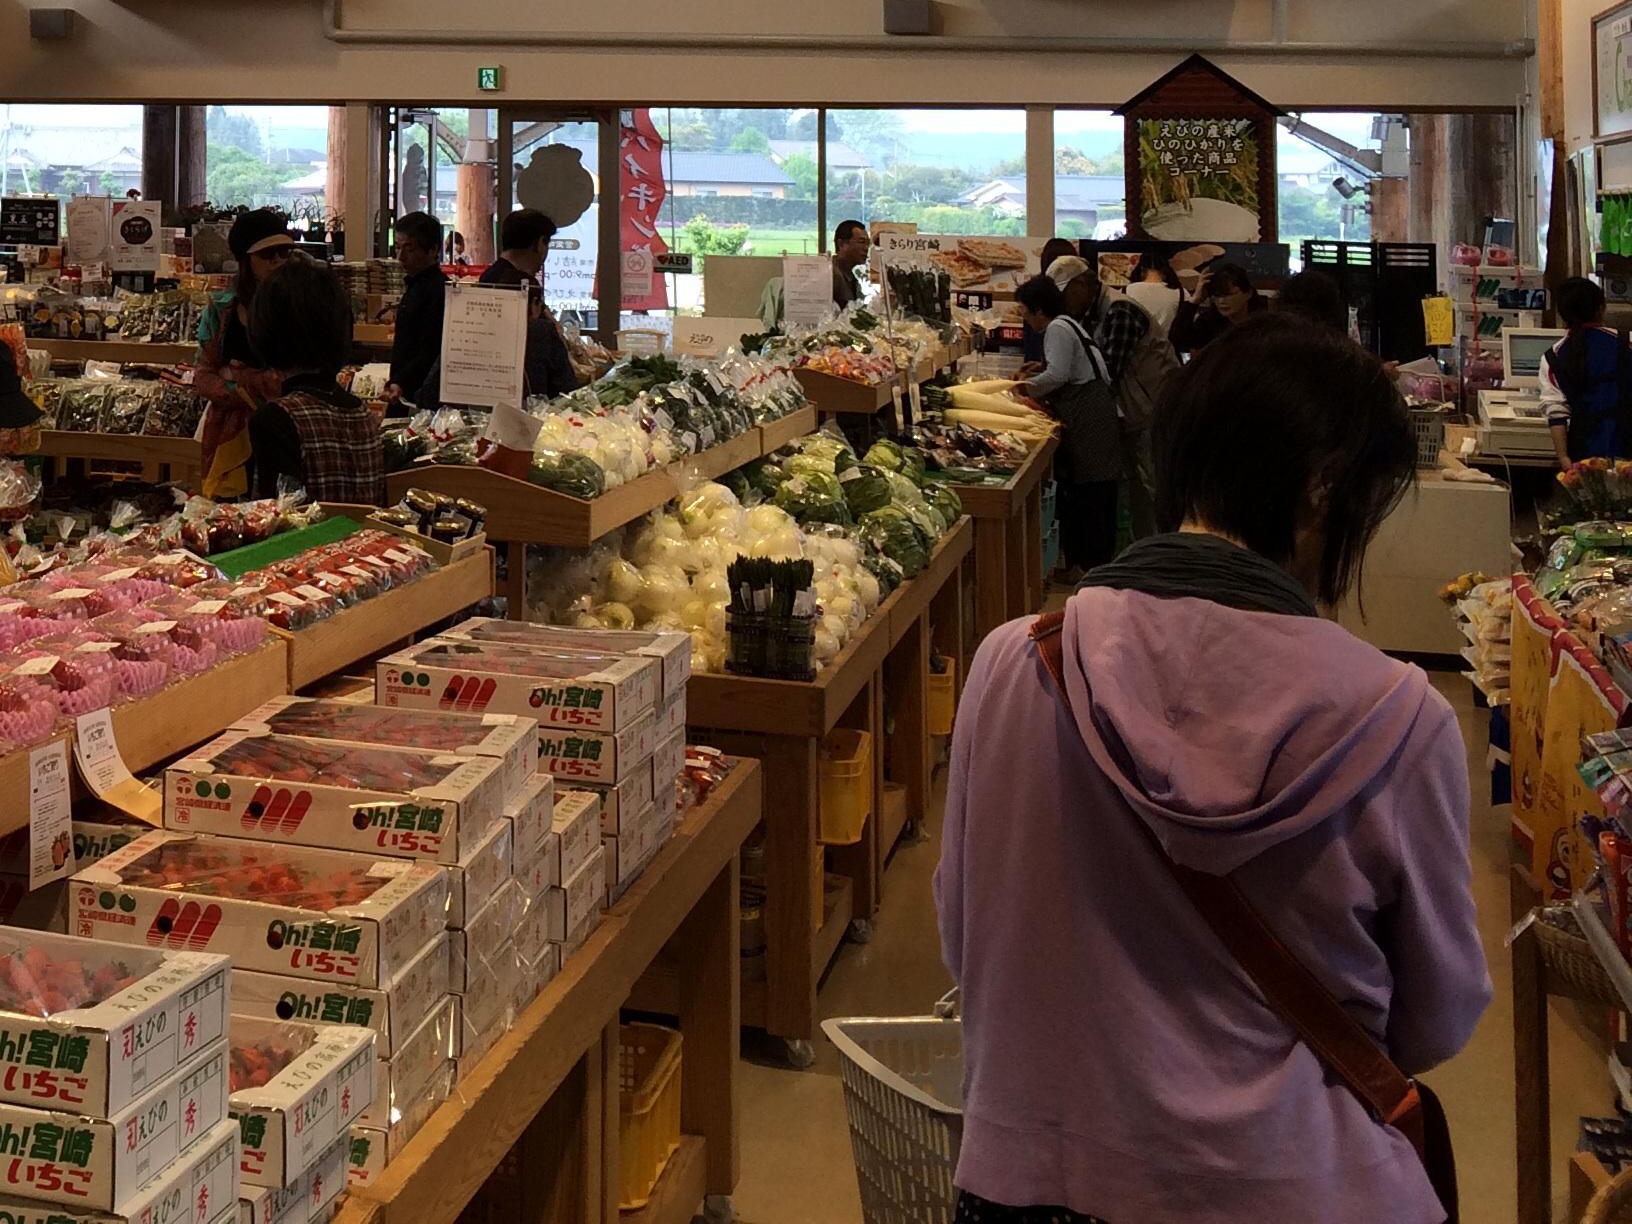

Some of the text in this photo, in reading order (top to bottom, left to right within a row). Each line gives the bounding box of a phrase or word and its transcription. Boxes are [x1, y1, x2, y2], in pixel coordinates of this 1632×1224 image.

[1160, 124, 1237, 138] えびの産米
[1152, 138, 1244, 151] ひのひかりを
[1160, 151, 1237, 165] 使った商品
[1169, 166, 1230, 177] コーナー
[889, 238, 940, 251] きらり宮崎
[667, 256, 689, 266] AED
[550, 707, 603, 726] いちご
[549, 758, 602, 778] いちご
[376, 829, 442, 855] いちご
[290, 949, 360, 977] いちご
[183, 1011, 197, 1049] 秀
[3, 1066, 89, 1103] いちご
[184, 1098, 197, 1136] 秀
[7, 1158, 94, 1197] いちご
[196, 1183, 209, 1223] 秀
